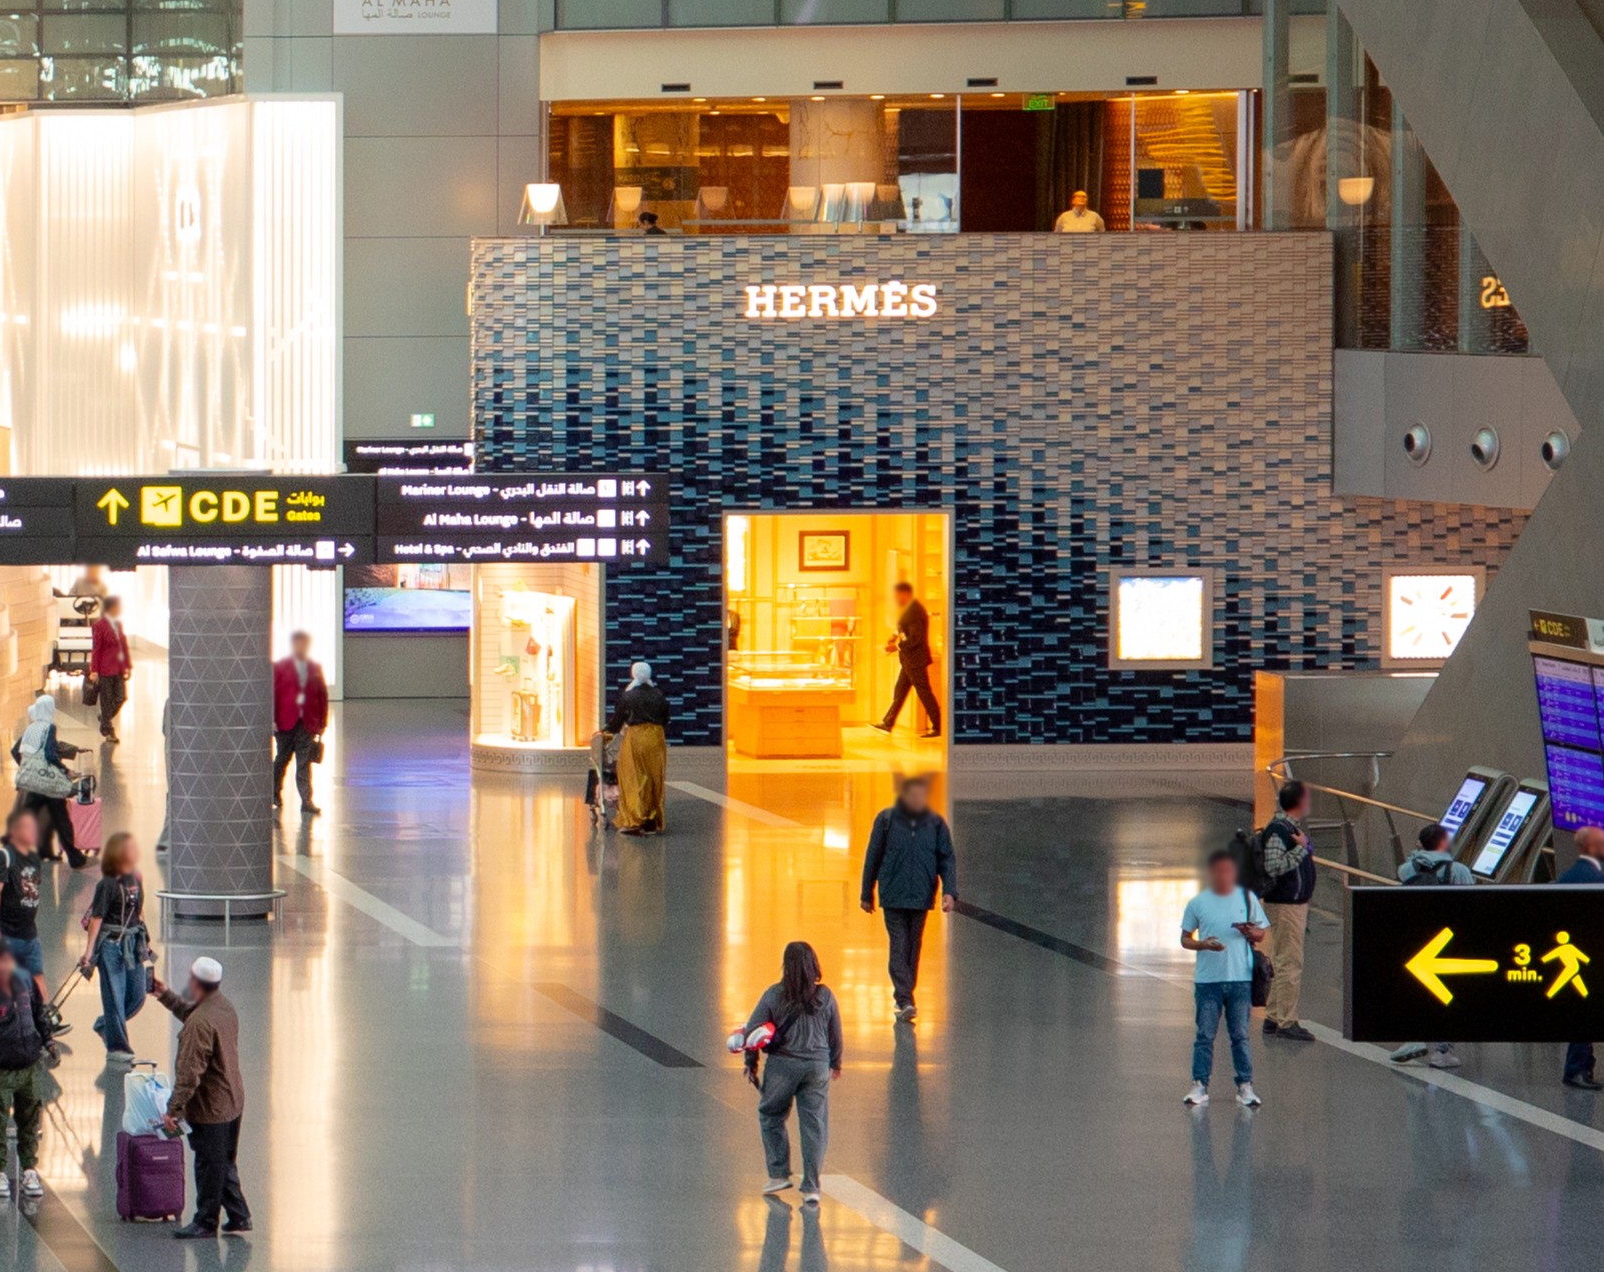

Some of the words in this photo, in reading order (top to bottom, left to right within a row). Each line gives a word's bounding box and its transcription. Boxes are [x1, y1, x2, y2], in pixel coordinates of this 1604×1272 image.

[417, 11, 452, 19] LOUNGE
[189, 490, 279, 523] CDE
[286, 510, 321, 522] Gates
[1514, 943, 1531, 966] 3
[1507, 967, 1543, 982] min.
